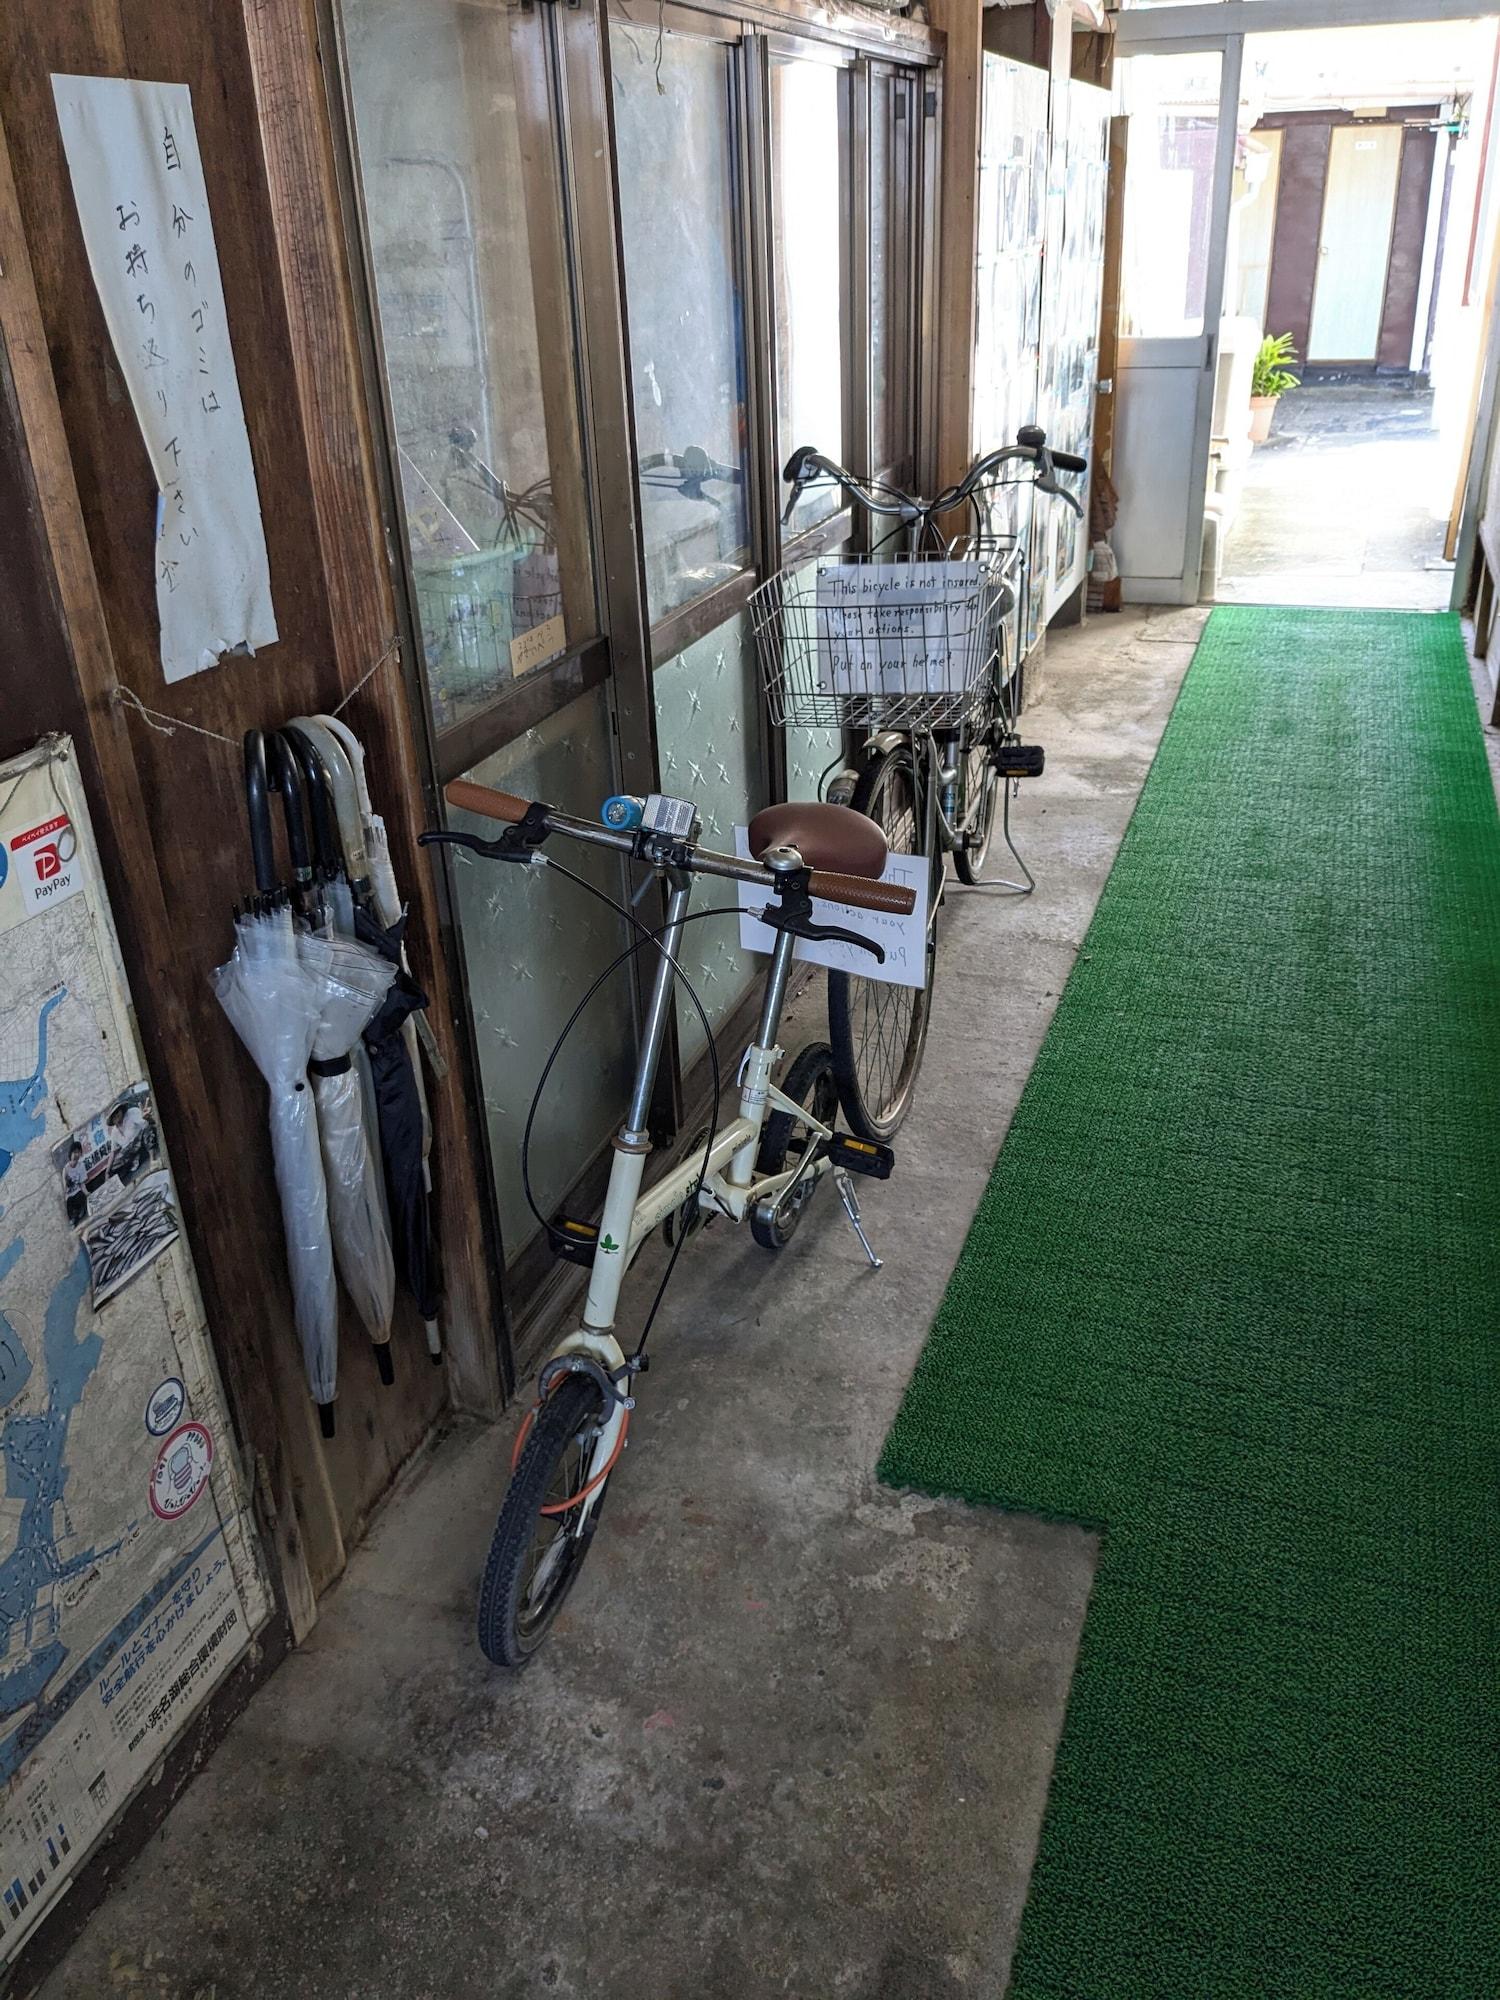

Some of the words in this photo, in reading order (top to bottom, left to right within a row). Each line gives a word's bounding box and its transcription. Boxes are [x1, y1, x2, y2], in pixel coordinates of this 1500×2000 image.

[162, 126, 222, 414] 自分のゴミは
[828, 579, 857, 598] This
[862, 577, 901, 598] bicycle
[919, 575, 937, 589] not
[868, 623, 915, 635] actions.
[832, 654, 854, 677] Put
[860, 660, 873, 671] on
[34, 873, 72, 900] PayPay
[99, 1567, 201, 1695] ルールとマナーを守り
